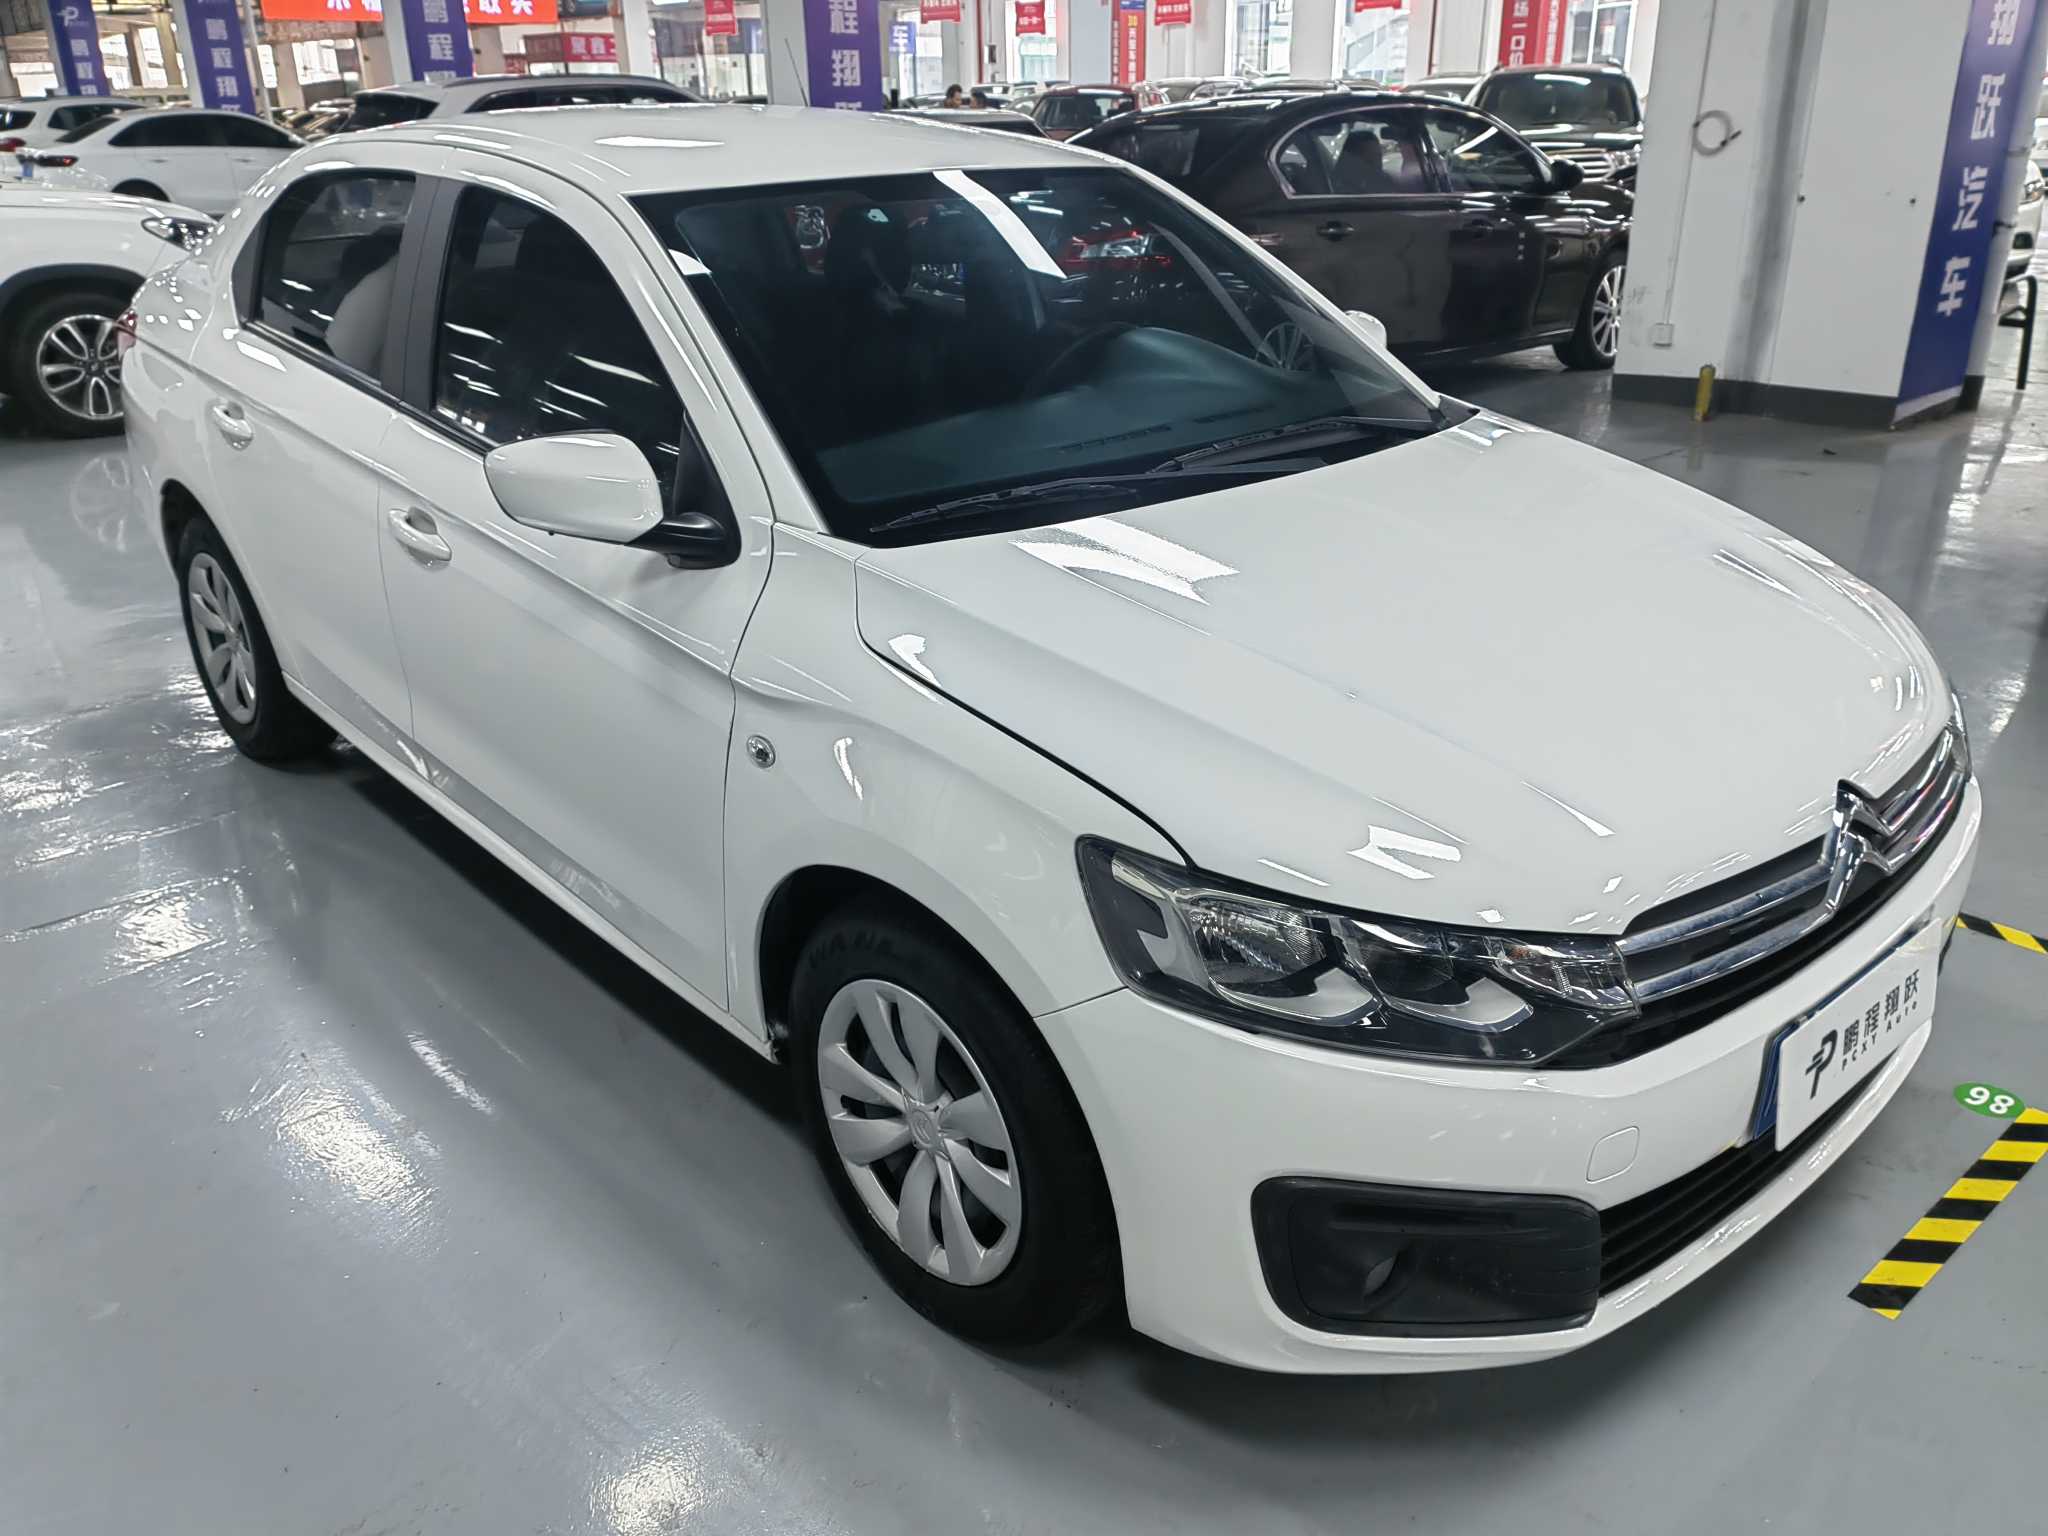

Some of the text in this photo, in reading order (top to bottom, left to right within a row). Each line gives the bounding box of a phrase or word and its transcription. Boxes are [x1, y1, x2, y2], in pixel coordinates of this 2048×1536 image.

[828, 0, 863, 110] 程翔
[1843, 968, 1920, 1056] 鹏程翔跃
[1963, 1086, 2015, 1115] 98
